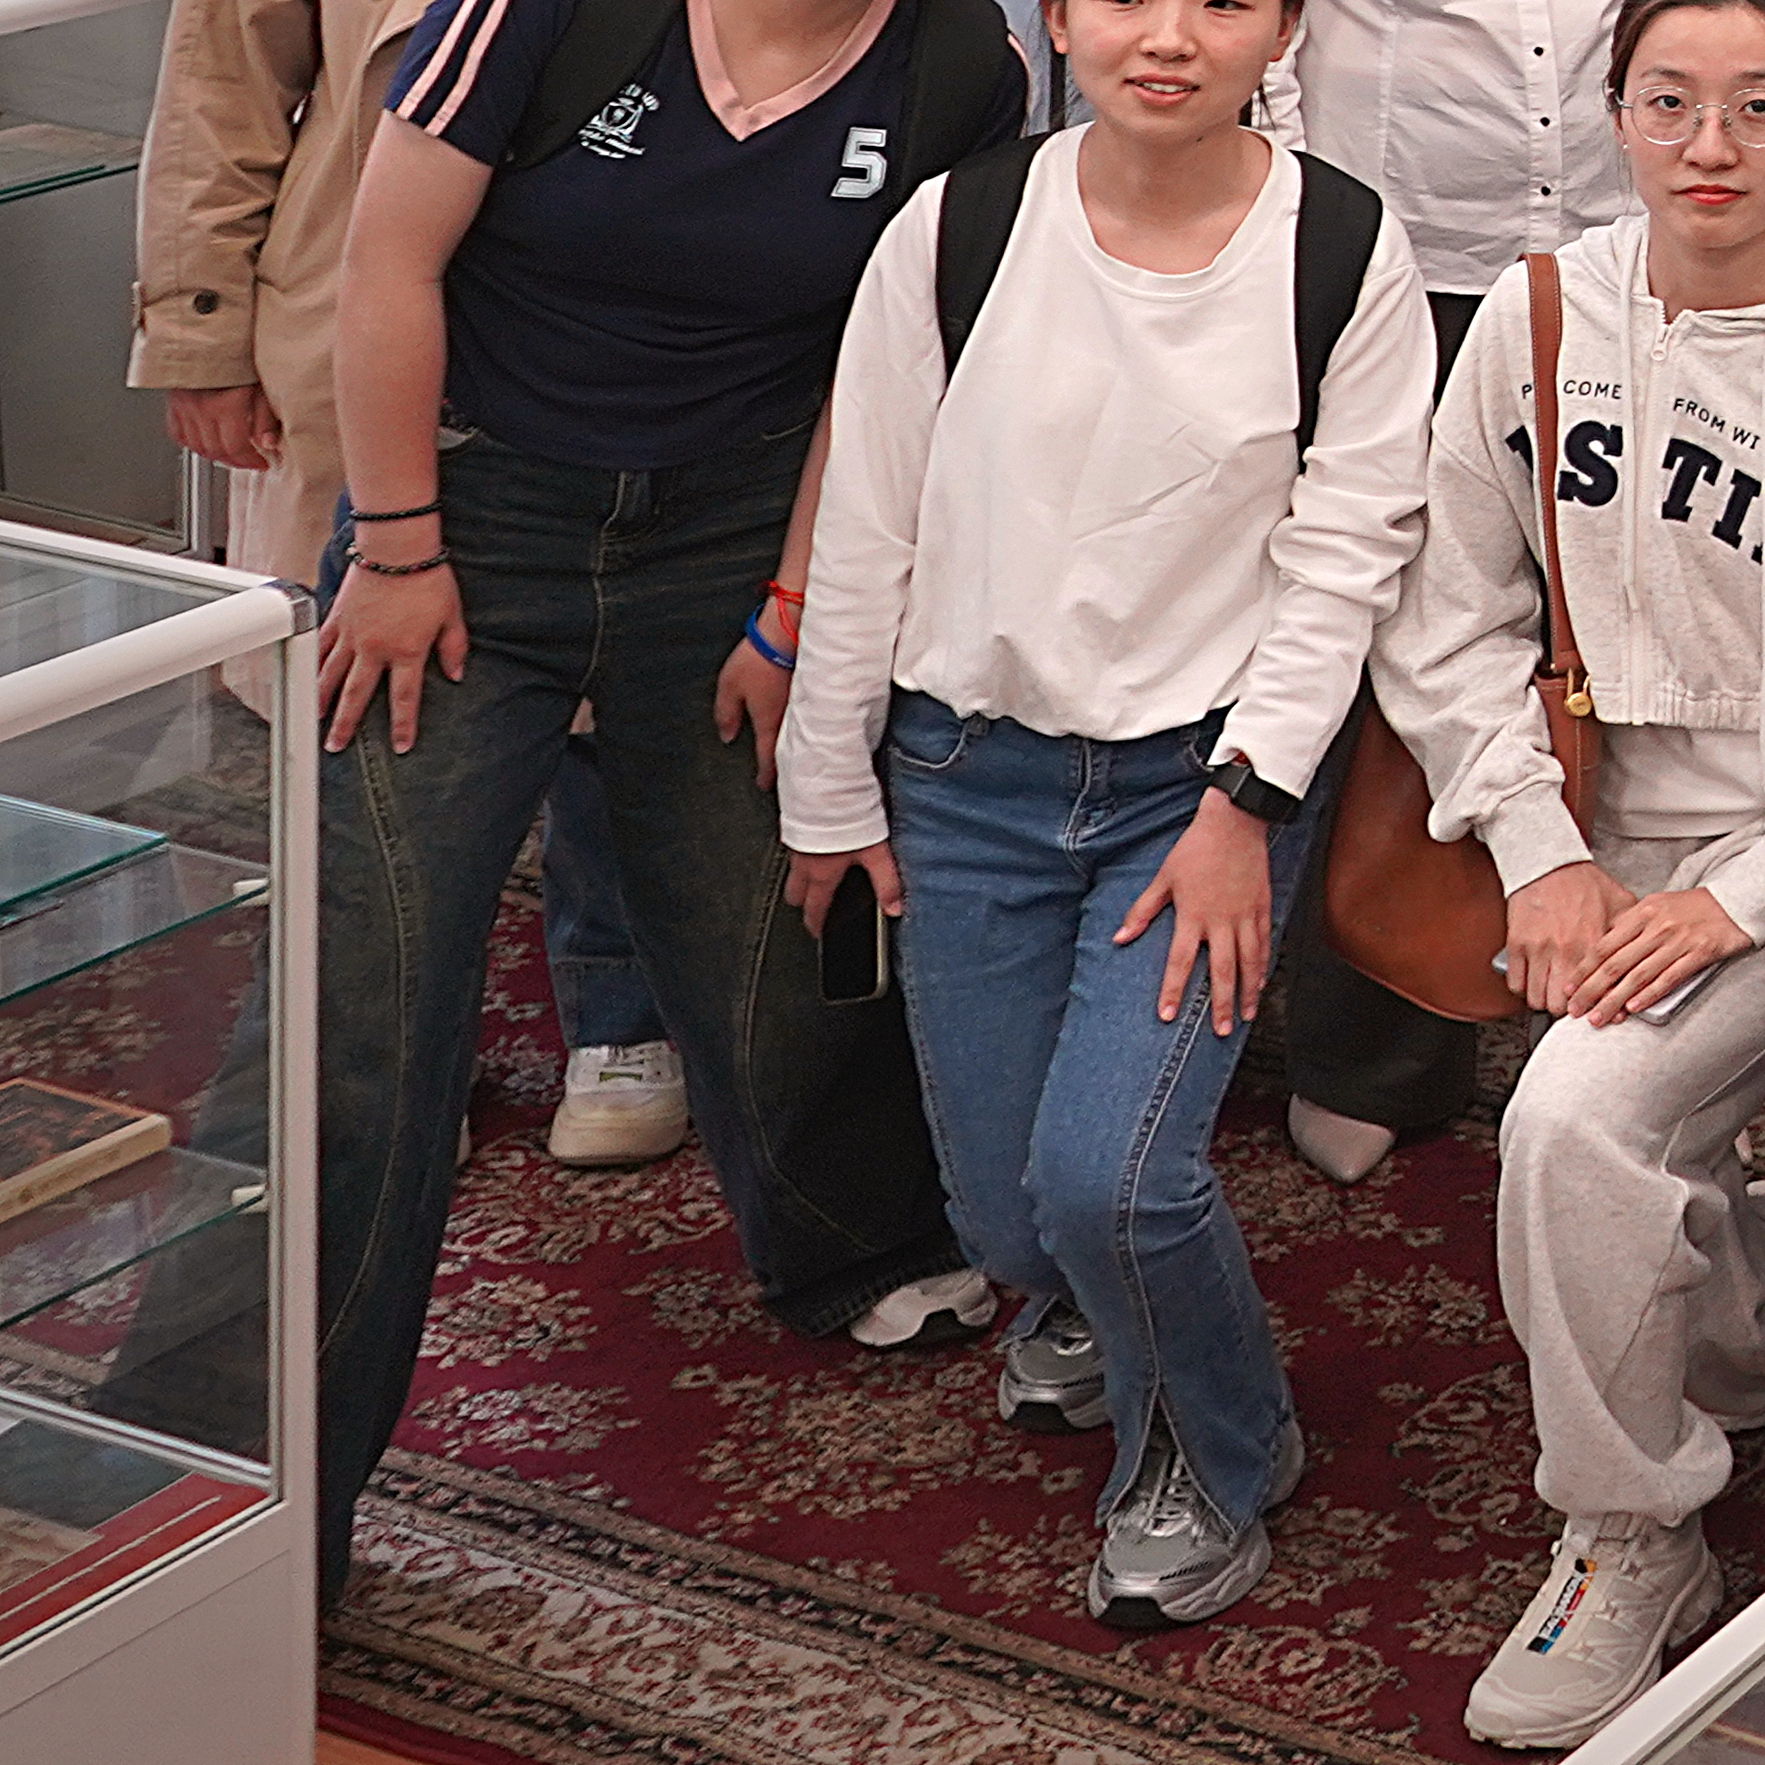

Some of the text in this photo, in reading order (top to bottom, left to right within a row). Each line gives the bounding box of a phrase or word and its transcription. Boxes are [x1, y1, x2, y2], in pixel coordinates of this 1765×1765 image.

[830, 126, 888, 199] 5
[1563, 380, 1622, 399] COME
[1673, 398, 1725, 433] FROM
